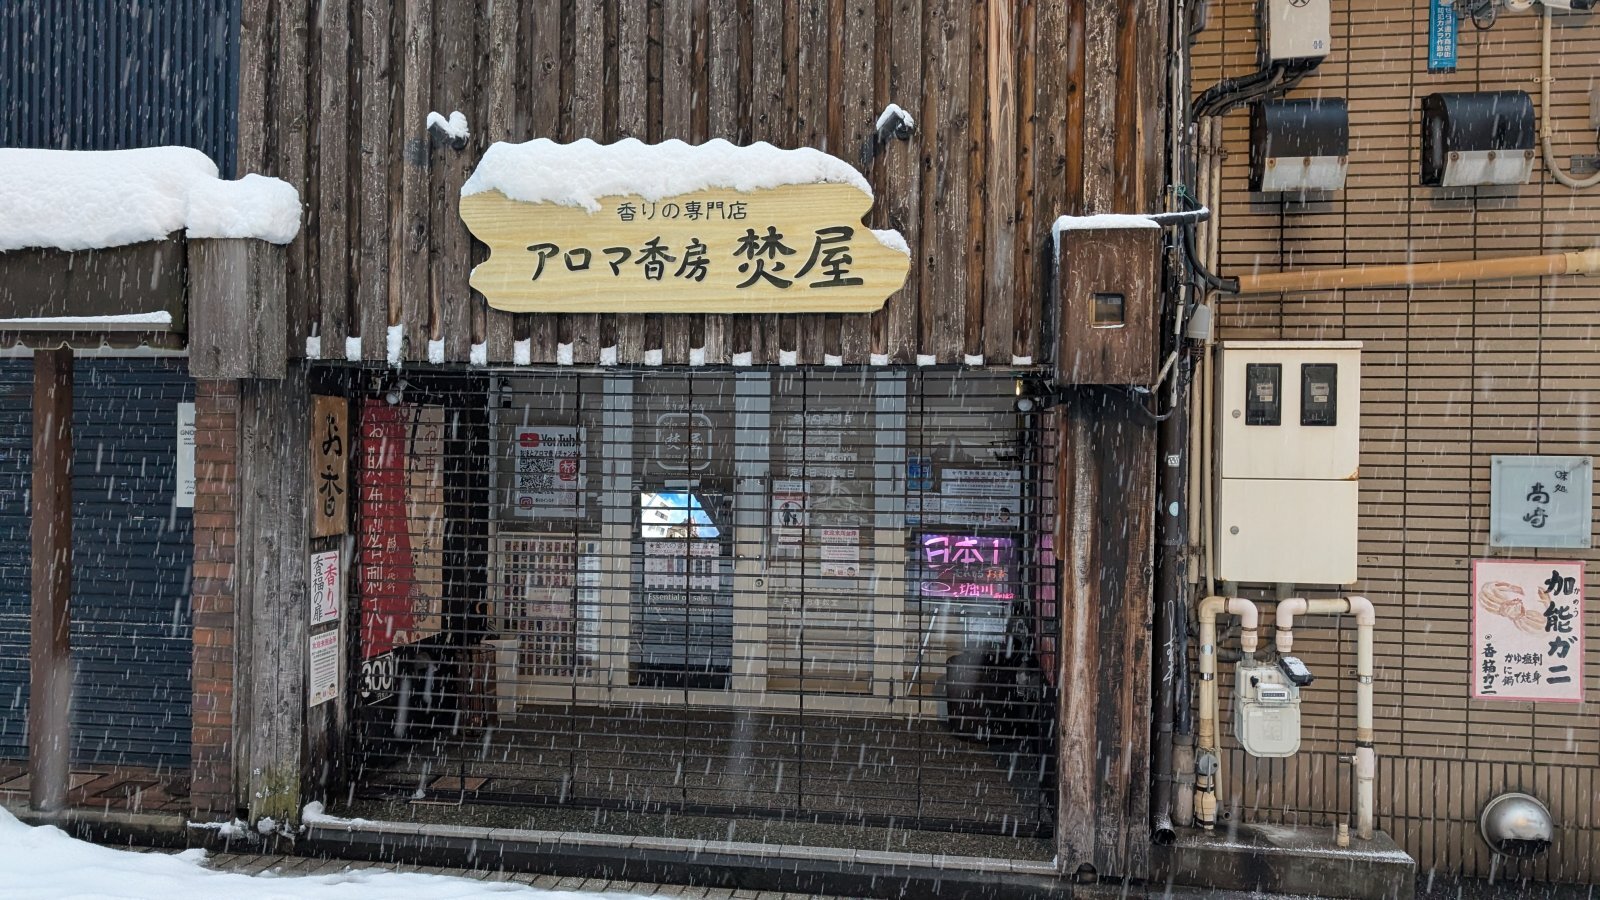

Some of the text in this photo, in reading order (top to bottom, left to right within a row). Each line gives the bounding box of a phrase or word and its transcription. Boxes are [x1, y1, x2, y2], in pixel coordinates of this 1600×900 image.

[1436, 8, 1445, 58] 防犯カメラ作動中
[616, 200, 748, 222] 香りの専門店
[526, 225, 864, 289] アロマ香房 焚屋
[319, 412, 343, 518] お香
[1553, 470, 1569, 494] 味処
[312, 555, 324, 622] 香福の扉
[323, 564, 338, 609] 香り
[648, 592, 680, 602] Essential
[1573, 587, 1581, 618] かのう
[1543, 569, 1579, 685] 加能ガニ
[361, 656, 392, 698] 300
[1481, 643, 1500, 695] 香箱ガニ
[1501, 653, 1514, 687] かに鍋
[1513, 653, 1522, 683] ゆで
[1520, 653, 1533, 684] 塩焼
[1532, 652, 1543, 684] 刺身
